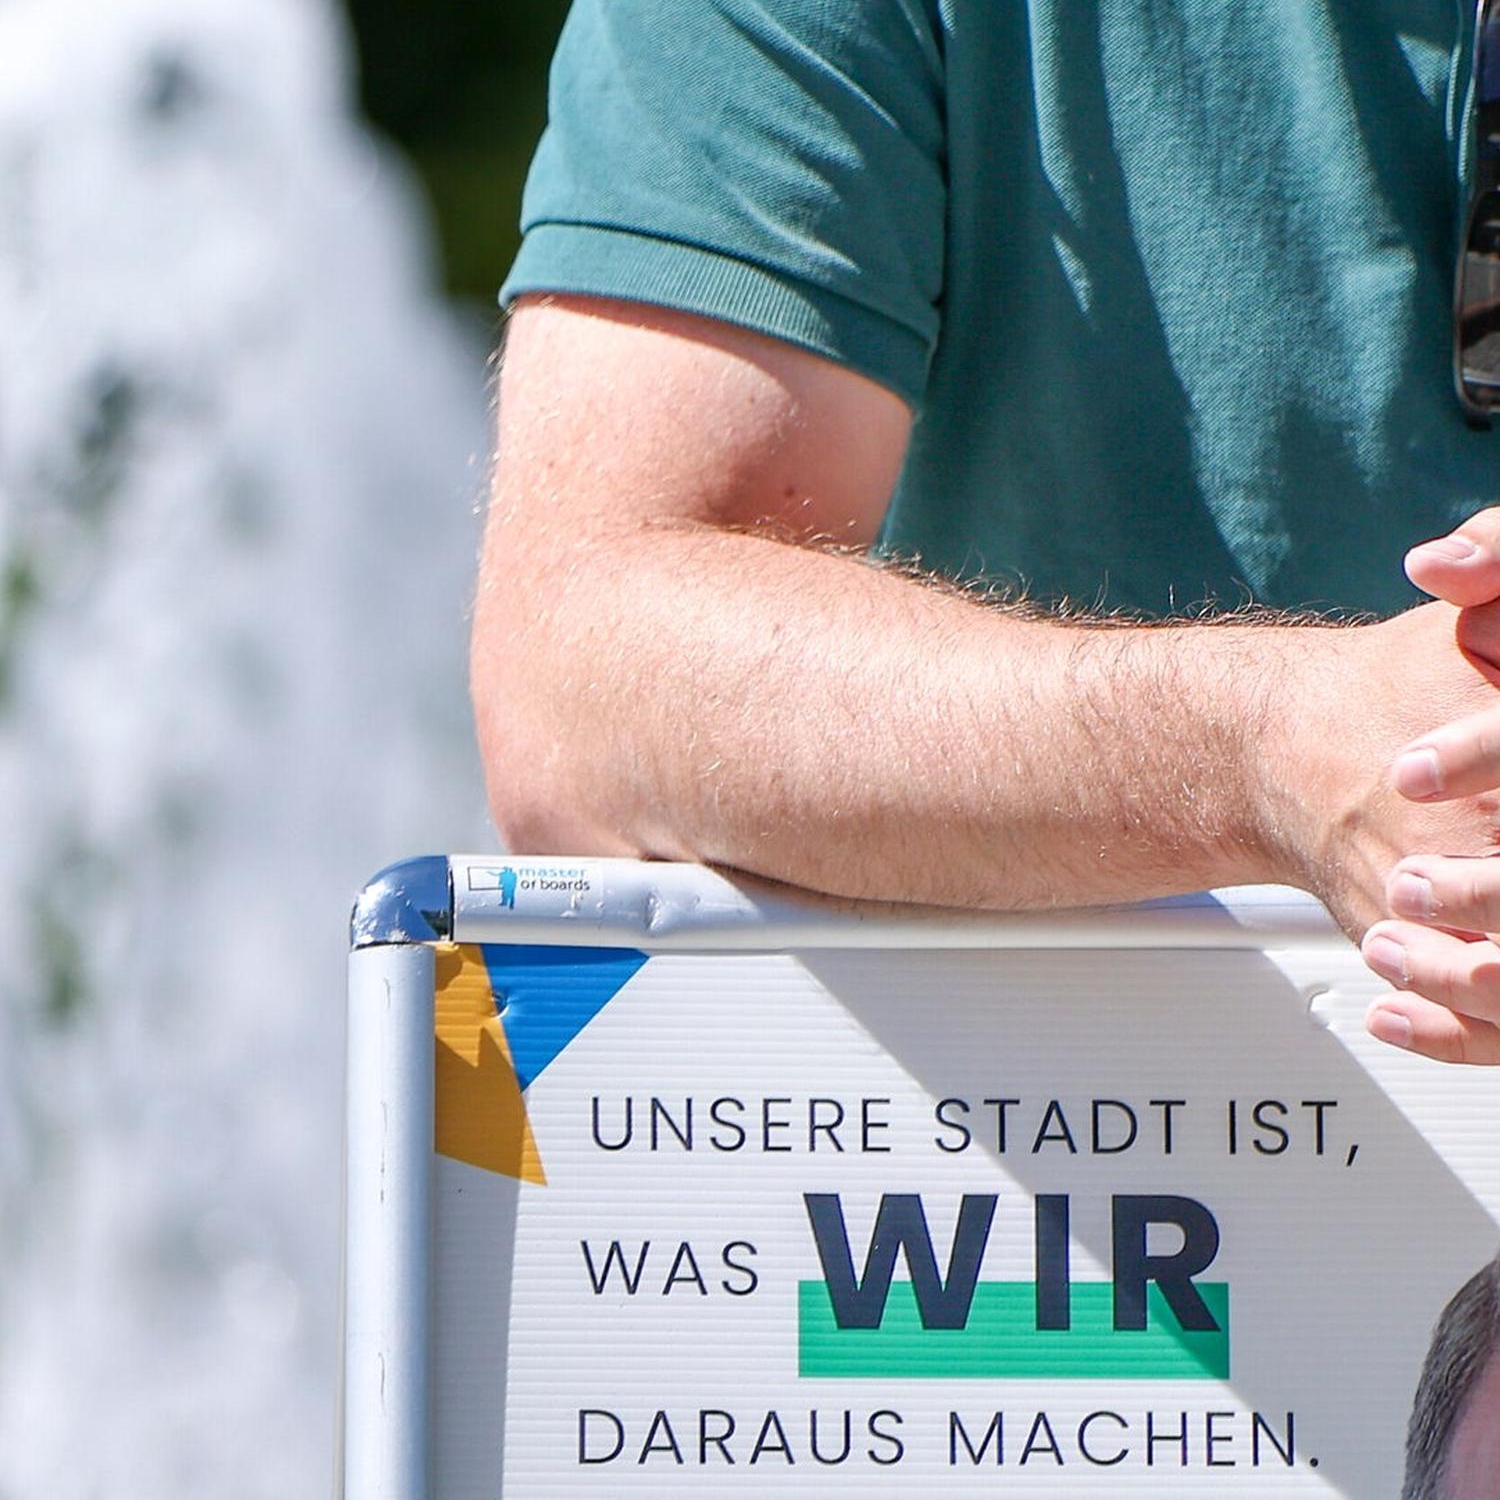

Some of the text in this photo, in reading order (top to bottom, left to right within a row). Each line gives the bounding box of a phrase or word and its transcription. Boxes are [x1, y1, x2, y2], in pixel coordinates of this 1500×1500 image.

[518, 867, 587, 878] master
[520, 878, 591, 892] of boards
[592, 1096, 1359, 1167] UNSERE STADT IST,
[581, 1193, 1224, 1334] WAS WIR
[579, 1409, 1320, 1468] DARAUS MACHEN.
